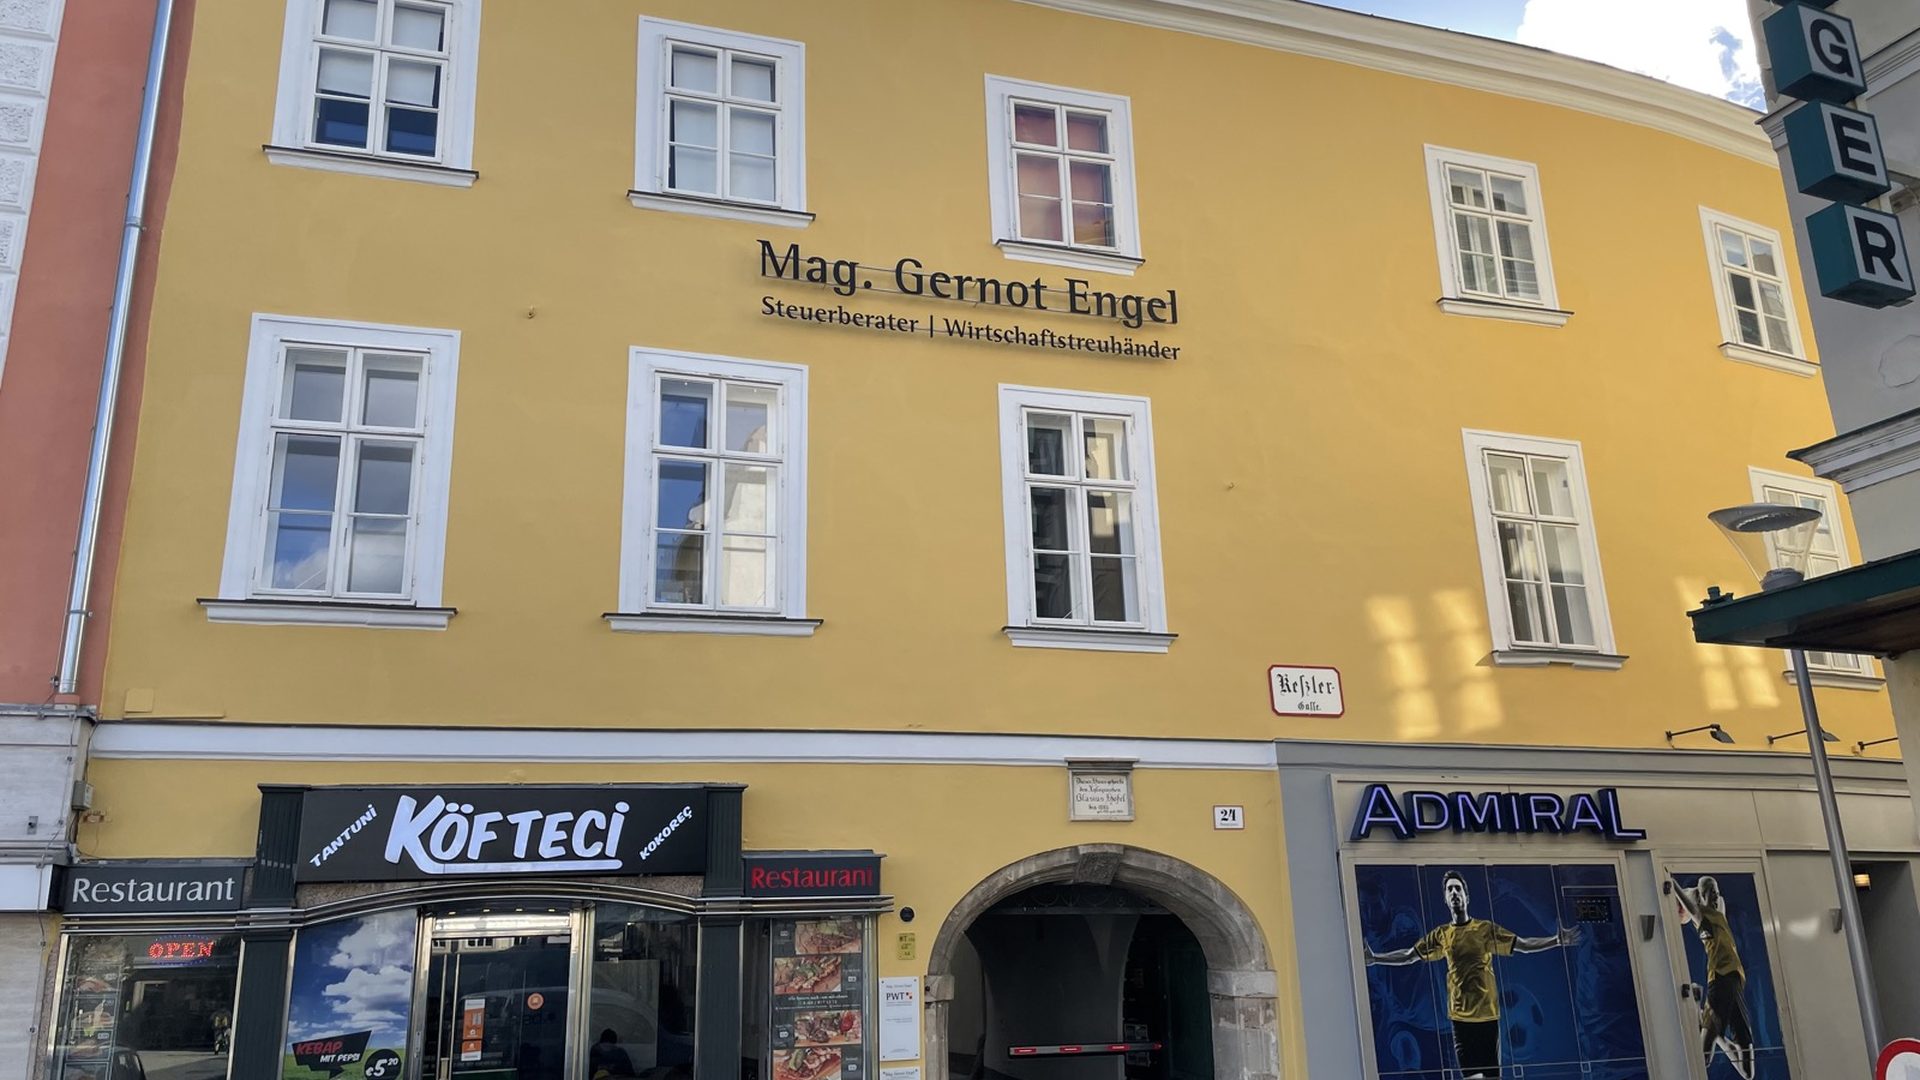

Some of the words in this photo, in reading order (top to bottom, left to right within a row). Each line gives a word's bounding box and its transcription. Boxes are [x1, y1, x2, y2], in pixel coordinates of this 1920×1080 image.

[757, 239, 873, 297] Mag.
[895, 258, 1047, 311] Gernot
[1064, 278, 1178, 329] Engel
[761, 295, 919, 333] Steuerberater
[943, 317, 1181, 361] Wirtschaftstreuhänder
[1220, 809, 1236, 821] 24
[1350, 783, 1647, 841] ADMIRAL
[72, 876, 235, 904] Restaurant
[147, 940, 215, 959] OPEN
[886, 992, 904, 1001] PWT
[296, 1041, 343, 1055] KEBAP
[320, 1054, 335, 1063] MIT
[337, 1053, 360, 1062] PEPSI
